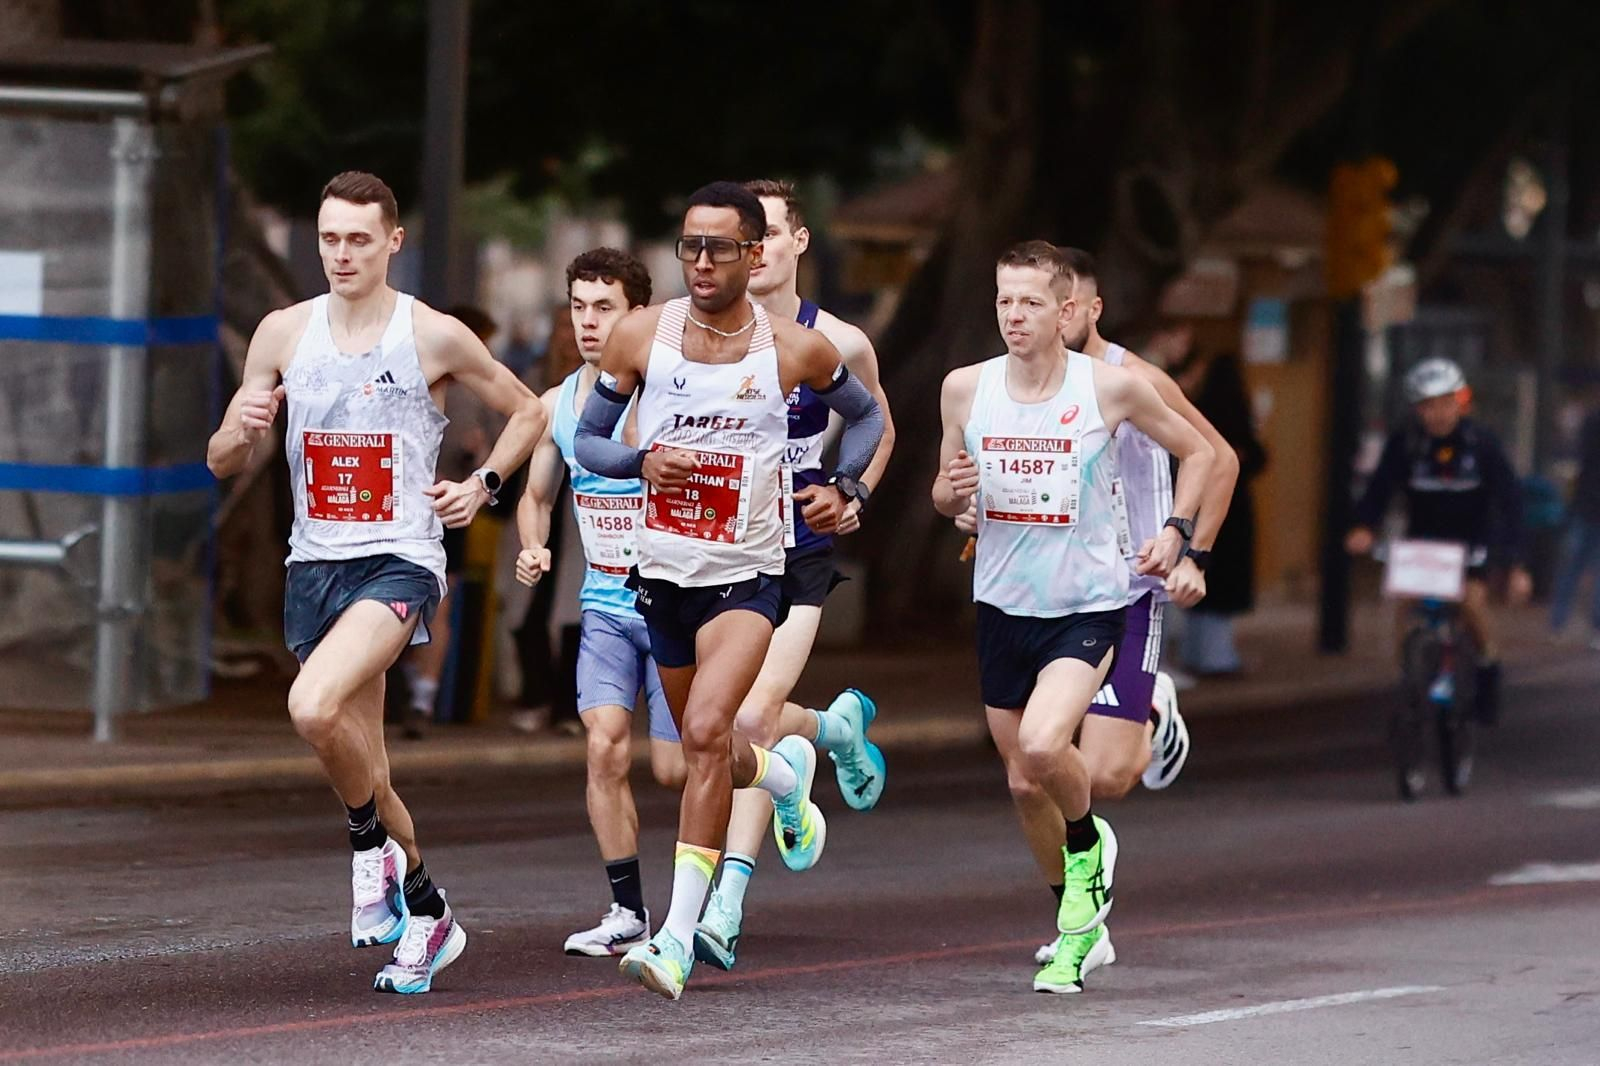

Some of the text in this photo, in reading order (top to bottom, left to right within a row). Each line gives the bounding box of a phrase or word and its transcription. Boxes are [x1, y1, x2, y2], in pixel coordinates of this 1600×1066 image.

[376, 386, 407, 396] MARTIN
[673, 413, 748, 430] TARGET
[323, 434, 386, 448] GENERALI
[1005, 439, 1064, 452] GENERALI
[331, 456, 360, 467] ALEX
[698, 452, 737, 468] ERALI
[999, 459, 1055, 474] 14587
[338, 473, 353, 485] 17
[686, 473, 724, 487] ATHAN
[685, 489, 699, 501] 18
[590, 498, 639, 509] GENERALI
[589, 515, 633, 531] 14588
